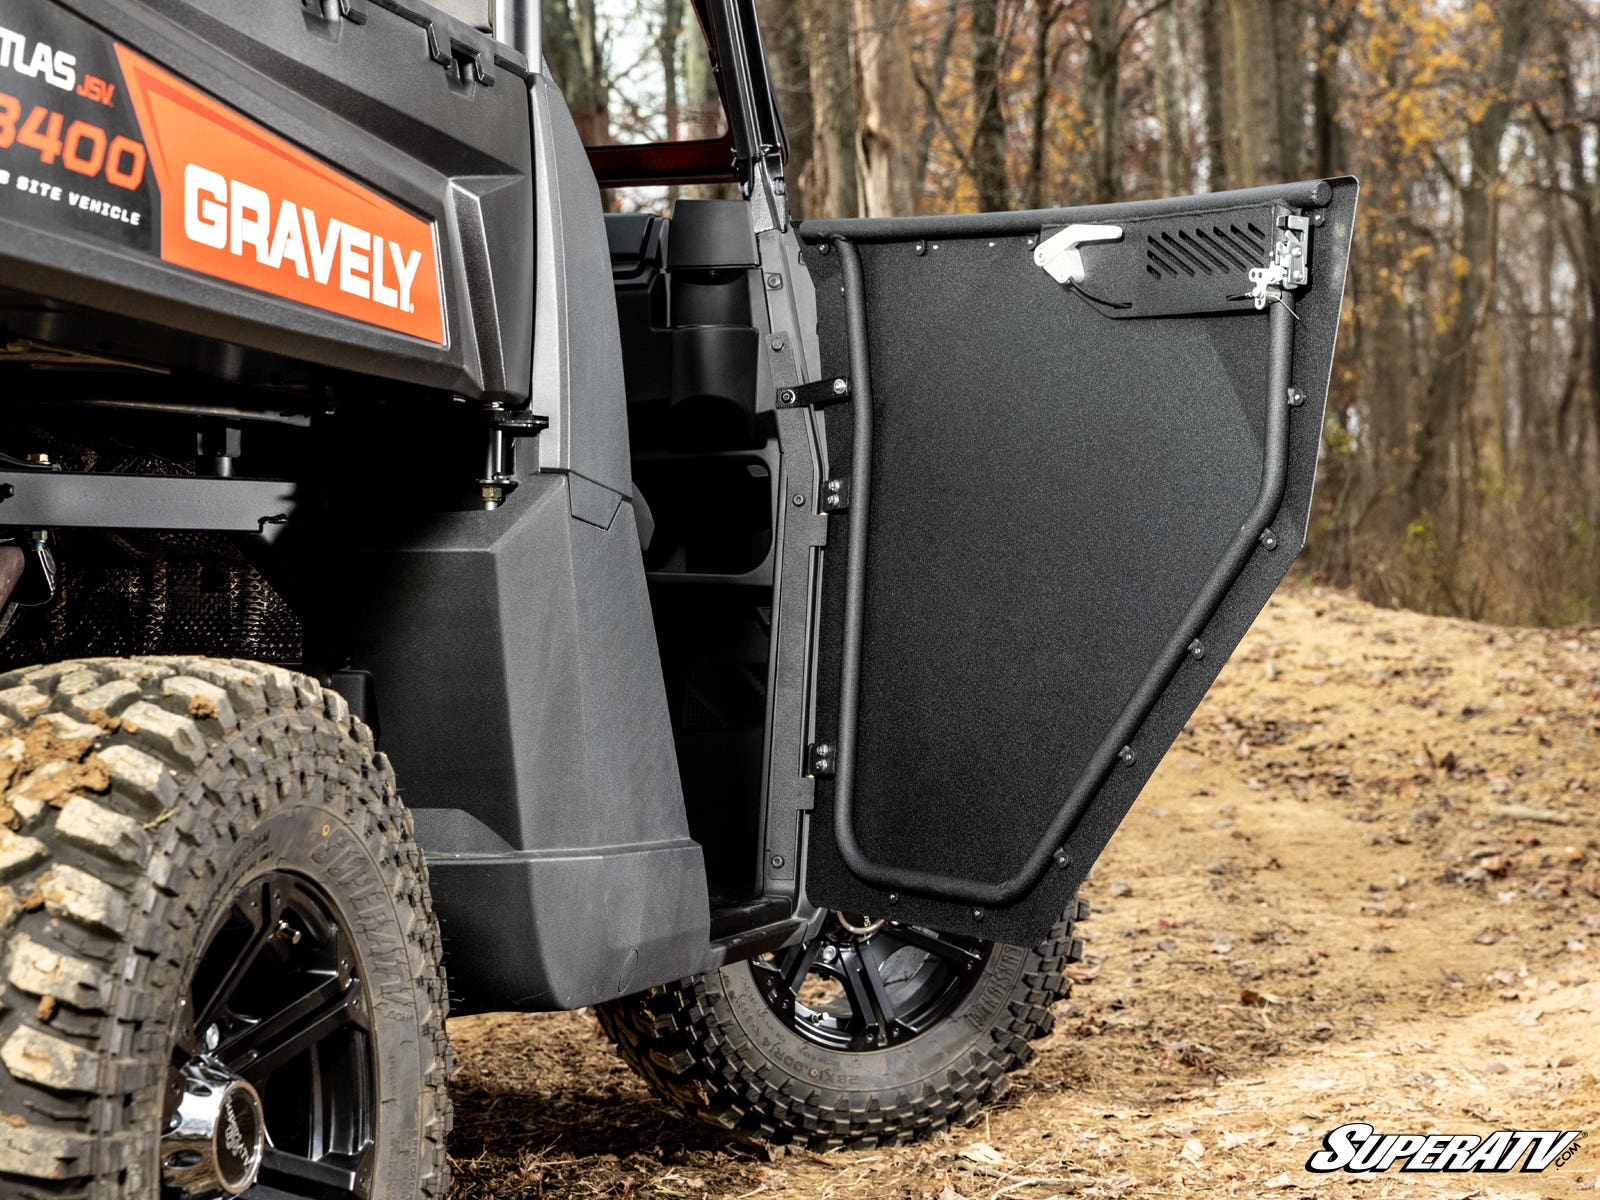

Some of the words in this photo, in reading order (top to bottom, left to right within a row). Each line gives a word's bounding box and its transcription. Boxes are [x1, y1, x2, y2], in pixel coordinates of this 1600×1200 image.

[16, 175, 62, 201] SITE
[68, 192, 141, 226] VEHICLE
[184, 163, 422, 313] GRAVELY
